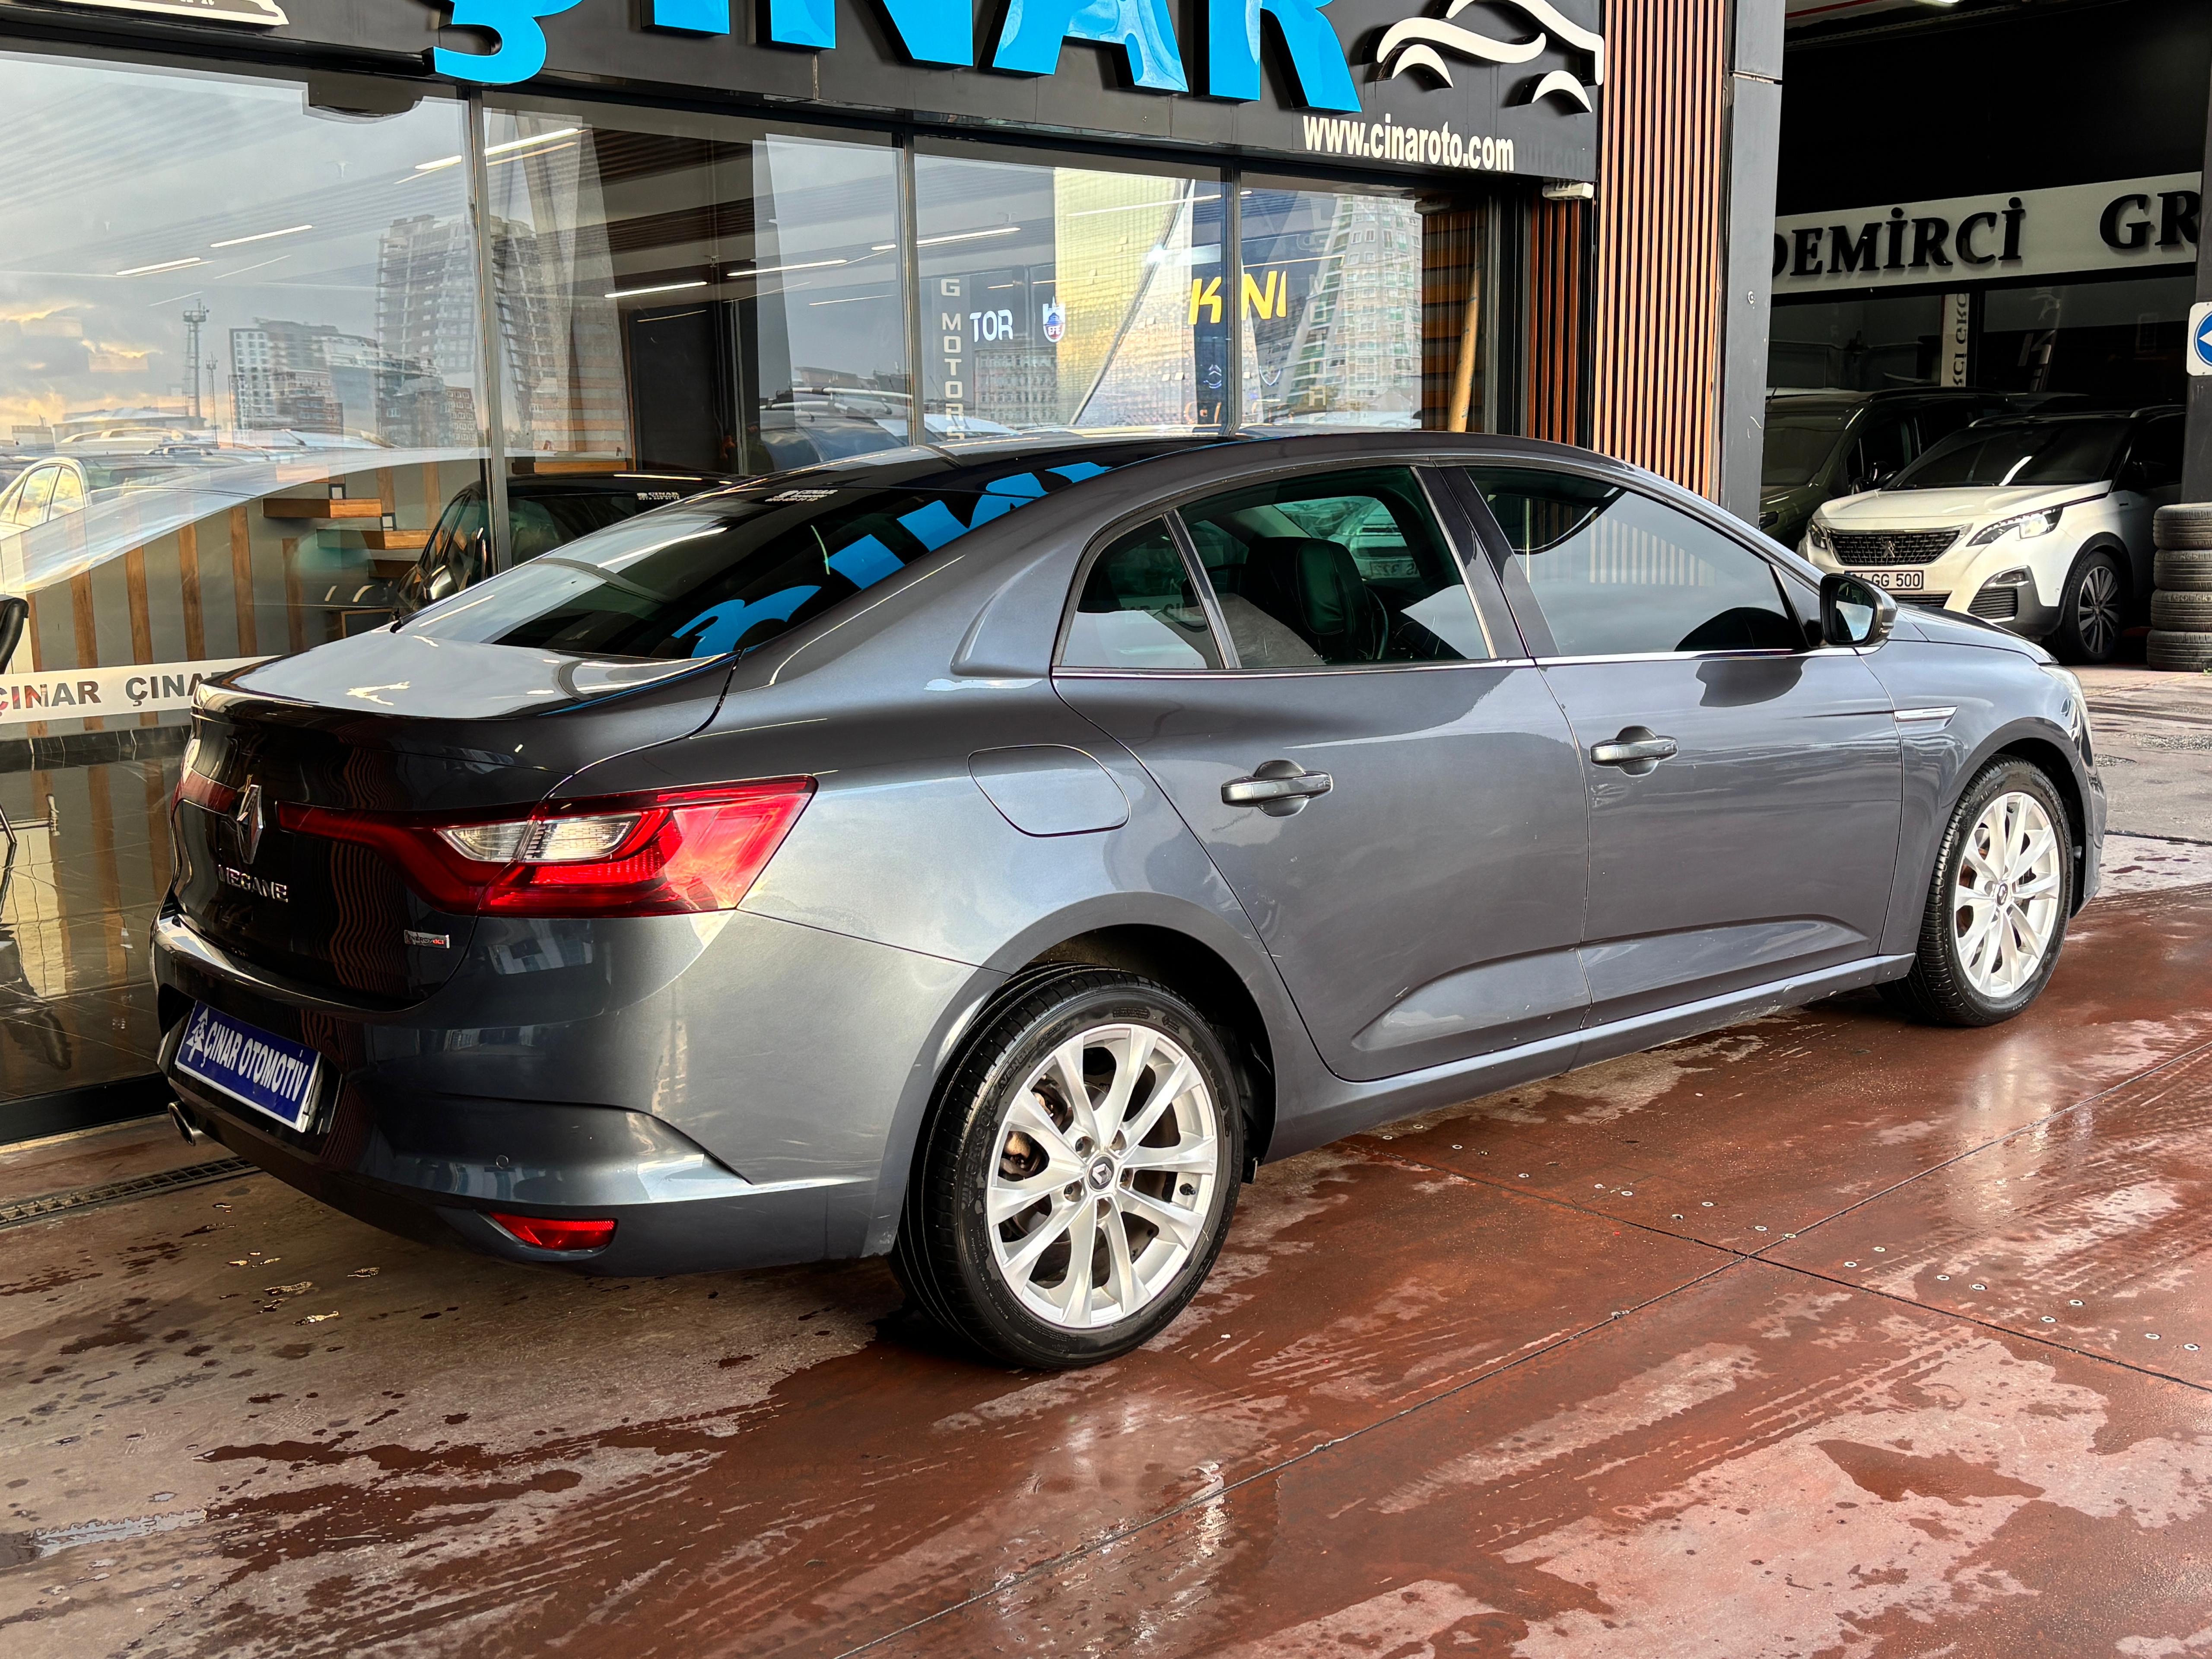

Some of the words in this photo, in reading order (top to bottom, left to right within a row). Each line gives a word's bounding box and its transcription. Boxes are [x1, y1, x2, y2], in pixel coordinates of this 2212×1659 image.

[1303, 113, 1514, 171] www.cinaroto.com
[1896, 573, 1920, 587] 500
[126, 671, 225, 707] ÇINA
[218, 864, 288, 903] MEGANE
[200, 1021, 243, 1068] ÇINAR
[238, 1038, 309, 1102] OTOMOTİV
